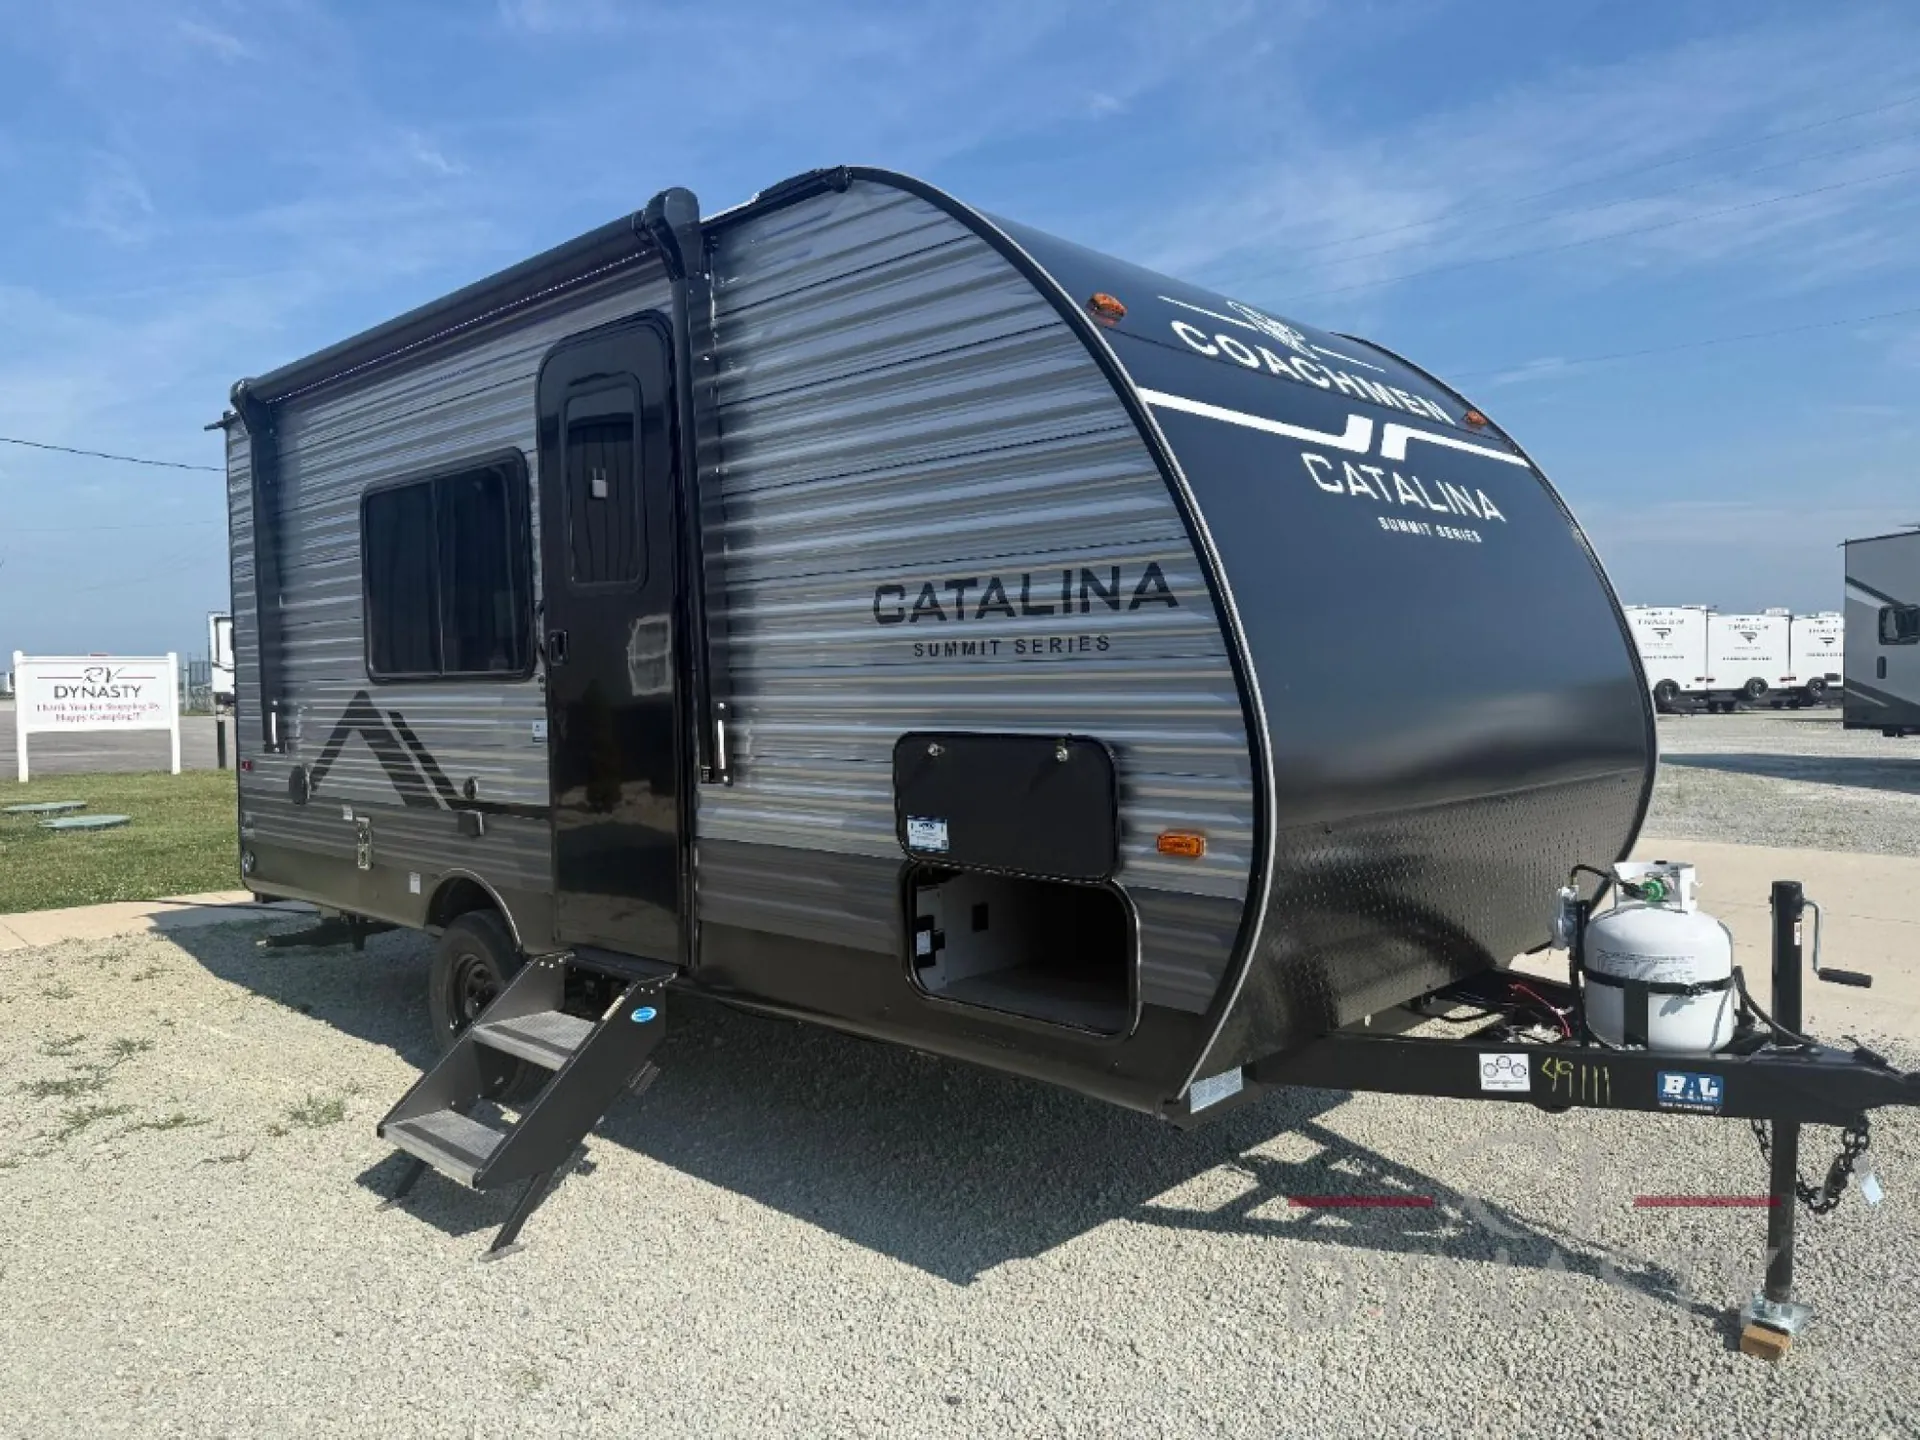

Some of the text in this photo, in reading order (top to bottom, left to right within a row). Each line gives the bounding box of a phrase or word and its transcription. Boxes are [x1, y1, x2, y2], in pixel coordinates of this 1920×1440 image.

[1170, 320, 1457, 426] COACHMEN
[1301, 452, 1507, 523] CATALINA
[1377, 515, 1483, 544] SUMMIT SERIES
[873, 561, 1180, 625] CATALINA
[914, 635, 1111, 658] SUMMIT SERIES
[54, 685, 142, 699] DYNASTY
